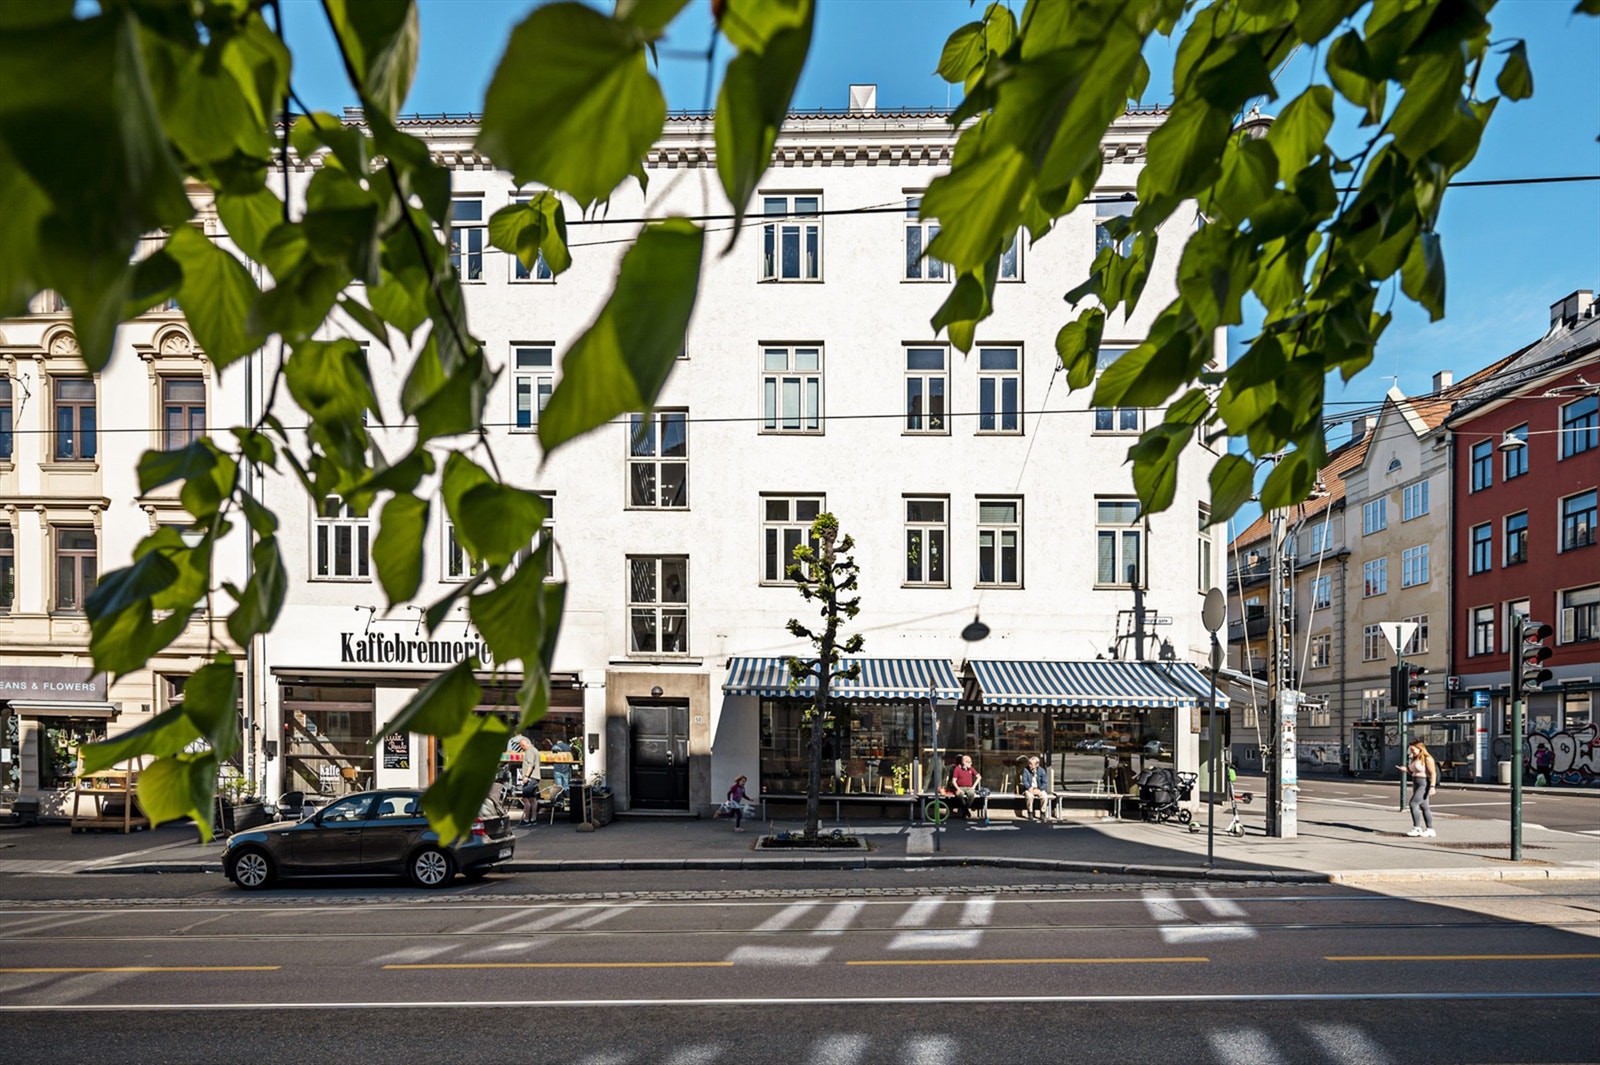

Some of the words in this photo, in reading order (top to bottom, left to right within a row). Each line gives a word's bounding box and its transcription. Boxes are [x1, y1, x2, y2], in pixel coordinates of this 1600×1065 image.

[340, 632, 493, 665] Kaffebrennerie
[31, 682, 39, 690] &
[43, 682, 96, 691] FLOWERS
[319, 764, 340, 776] Kaffe
